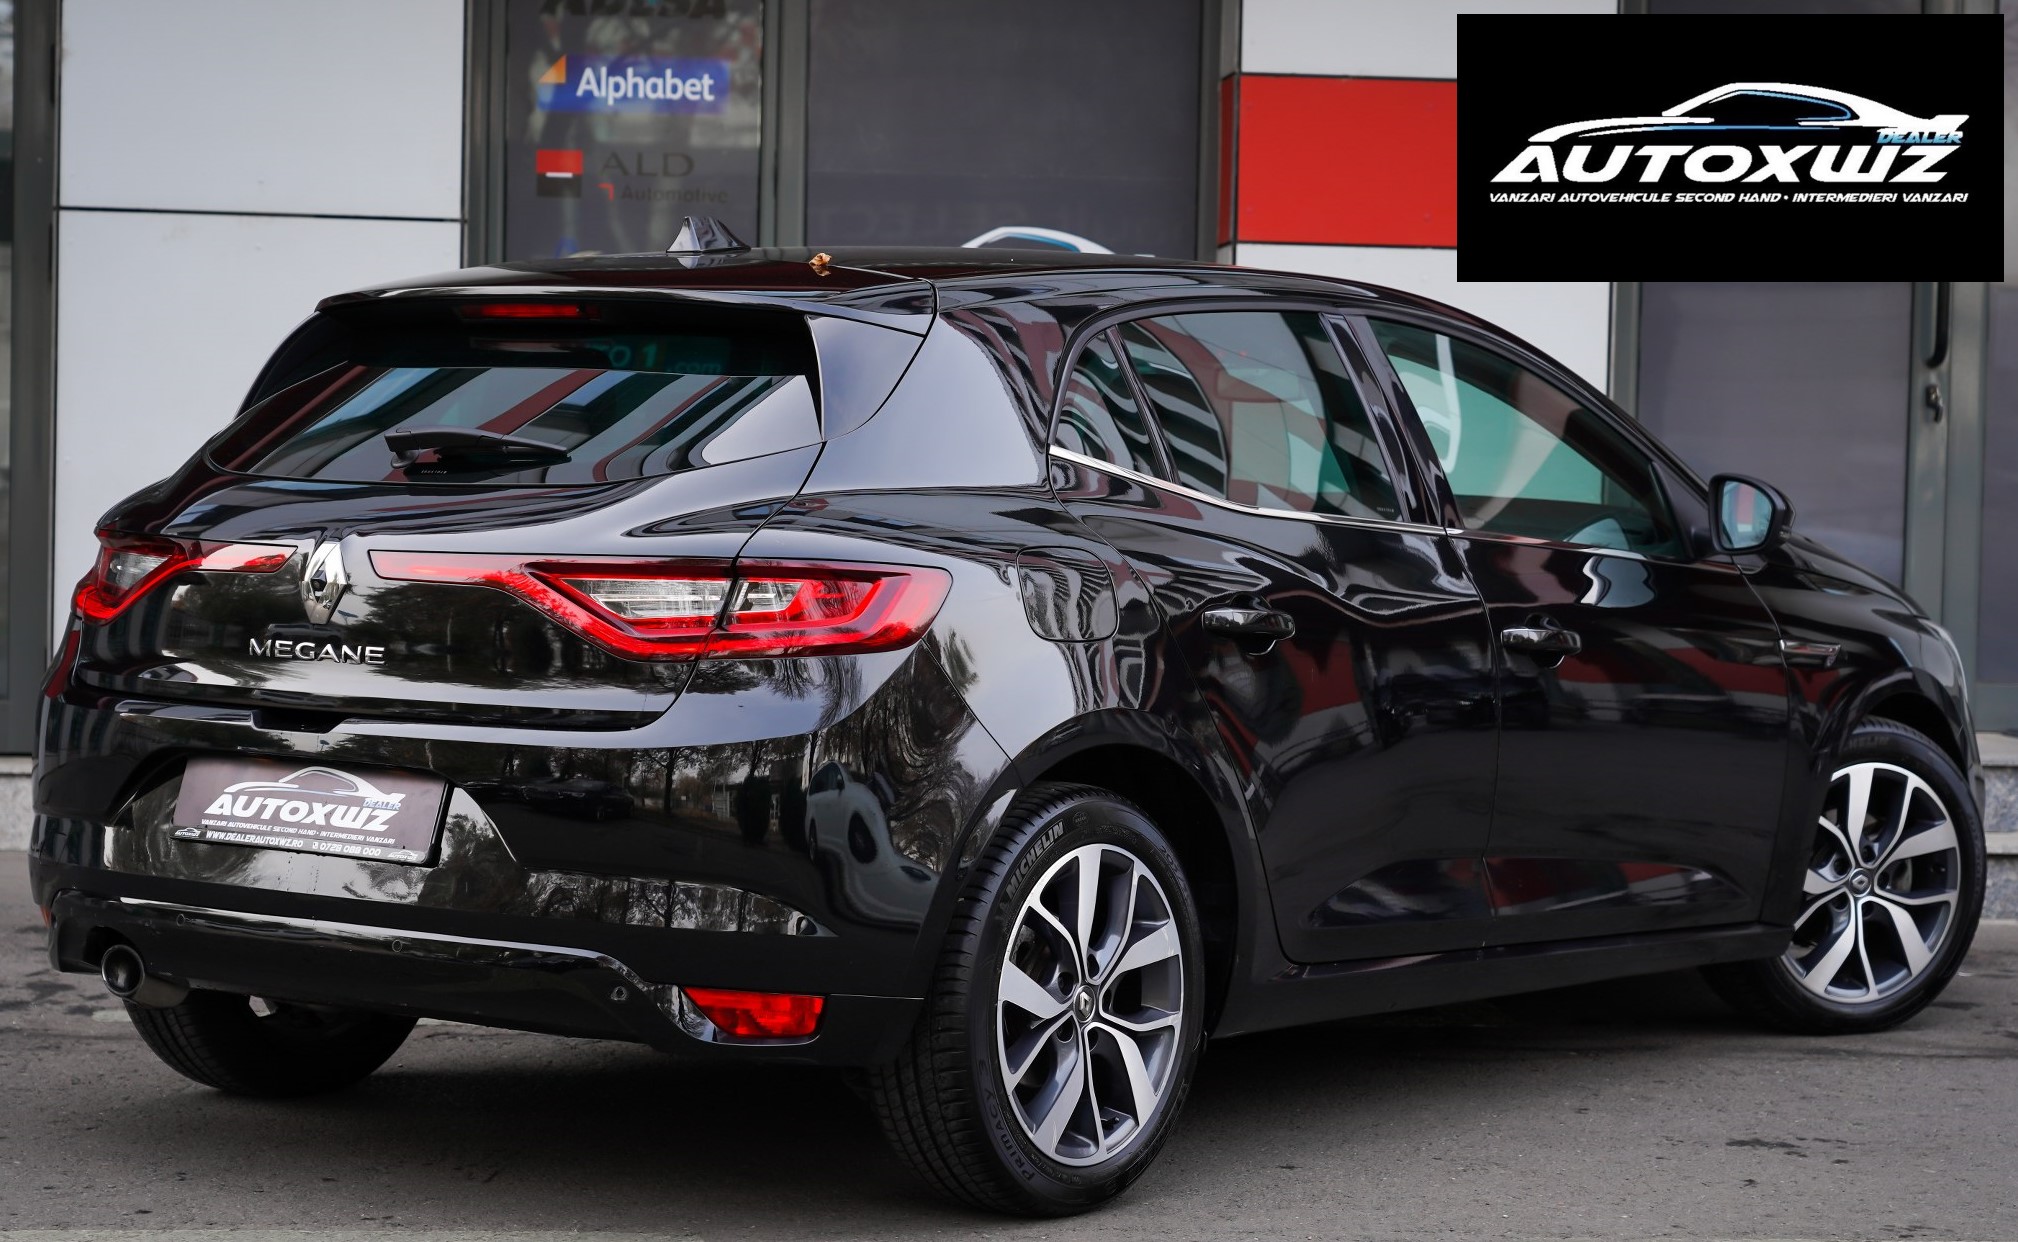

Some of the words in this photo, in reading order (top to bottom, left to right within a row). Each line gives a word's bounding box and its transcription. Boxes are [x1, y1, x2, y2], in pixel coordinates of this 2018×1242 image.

[576, 66, 715, 106] Alphabet
[599, 151, 695, 177] ALD
[621, 184, 729, 204] Automotive
[249, 638, 385, 665] MEGANE
[204, 794, 399, 831] AUTOXWZ
[362, 797, 402, 810] DEALER
[201, 818, 227, 827] VANZARI
[226, 820, 272, 832] AUTOVEHICULE
[272, 826, 298, 835] SECOND
[319, 831, 365, 842] INTERMEDIERI
[365, 836, 395, 845] VANZARI
[206, 830, 304, 849] WWW.DEALERAUTOXWZ.RO
[363, 846, 381, 857] 000
[1006, 821, 1064, 900] MICHELIN
[984, 1089, 1037, 1181] PRIMACY
